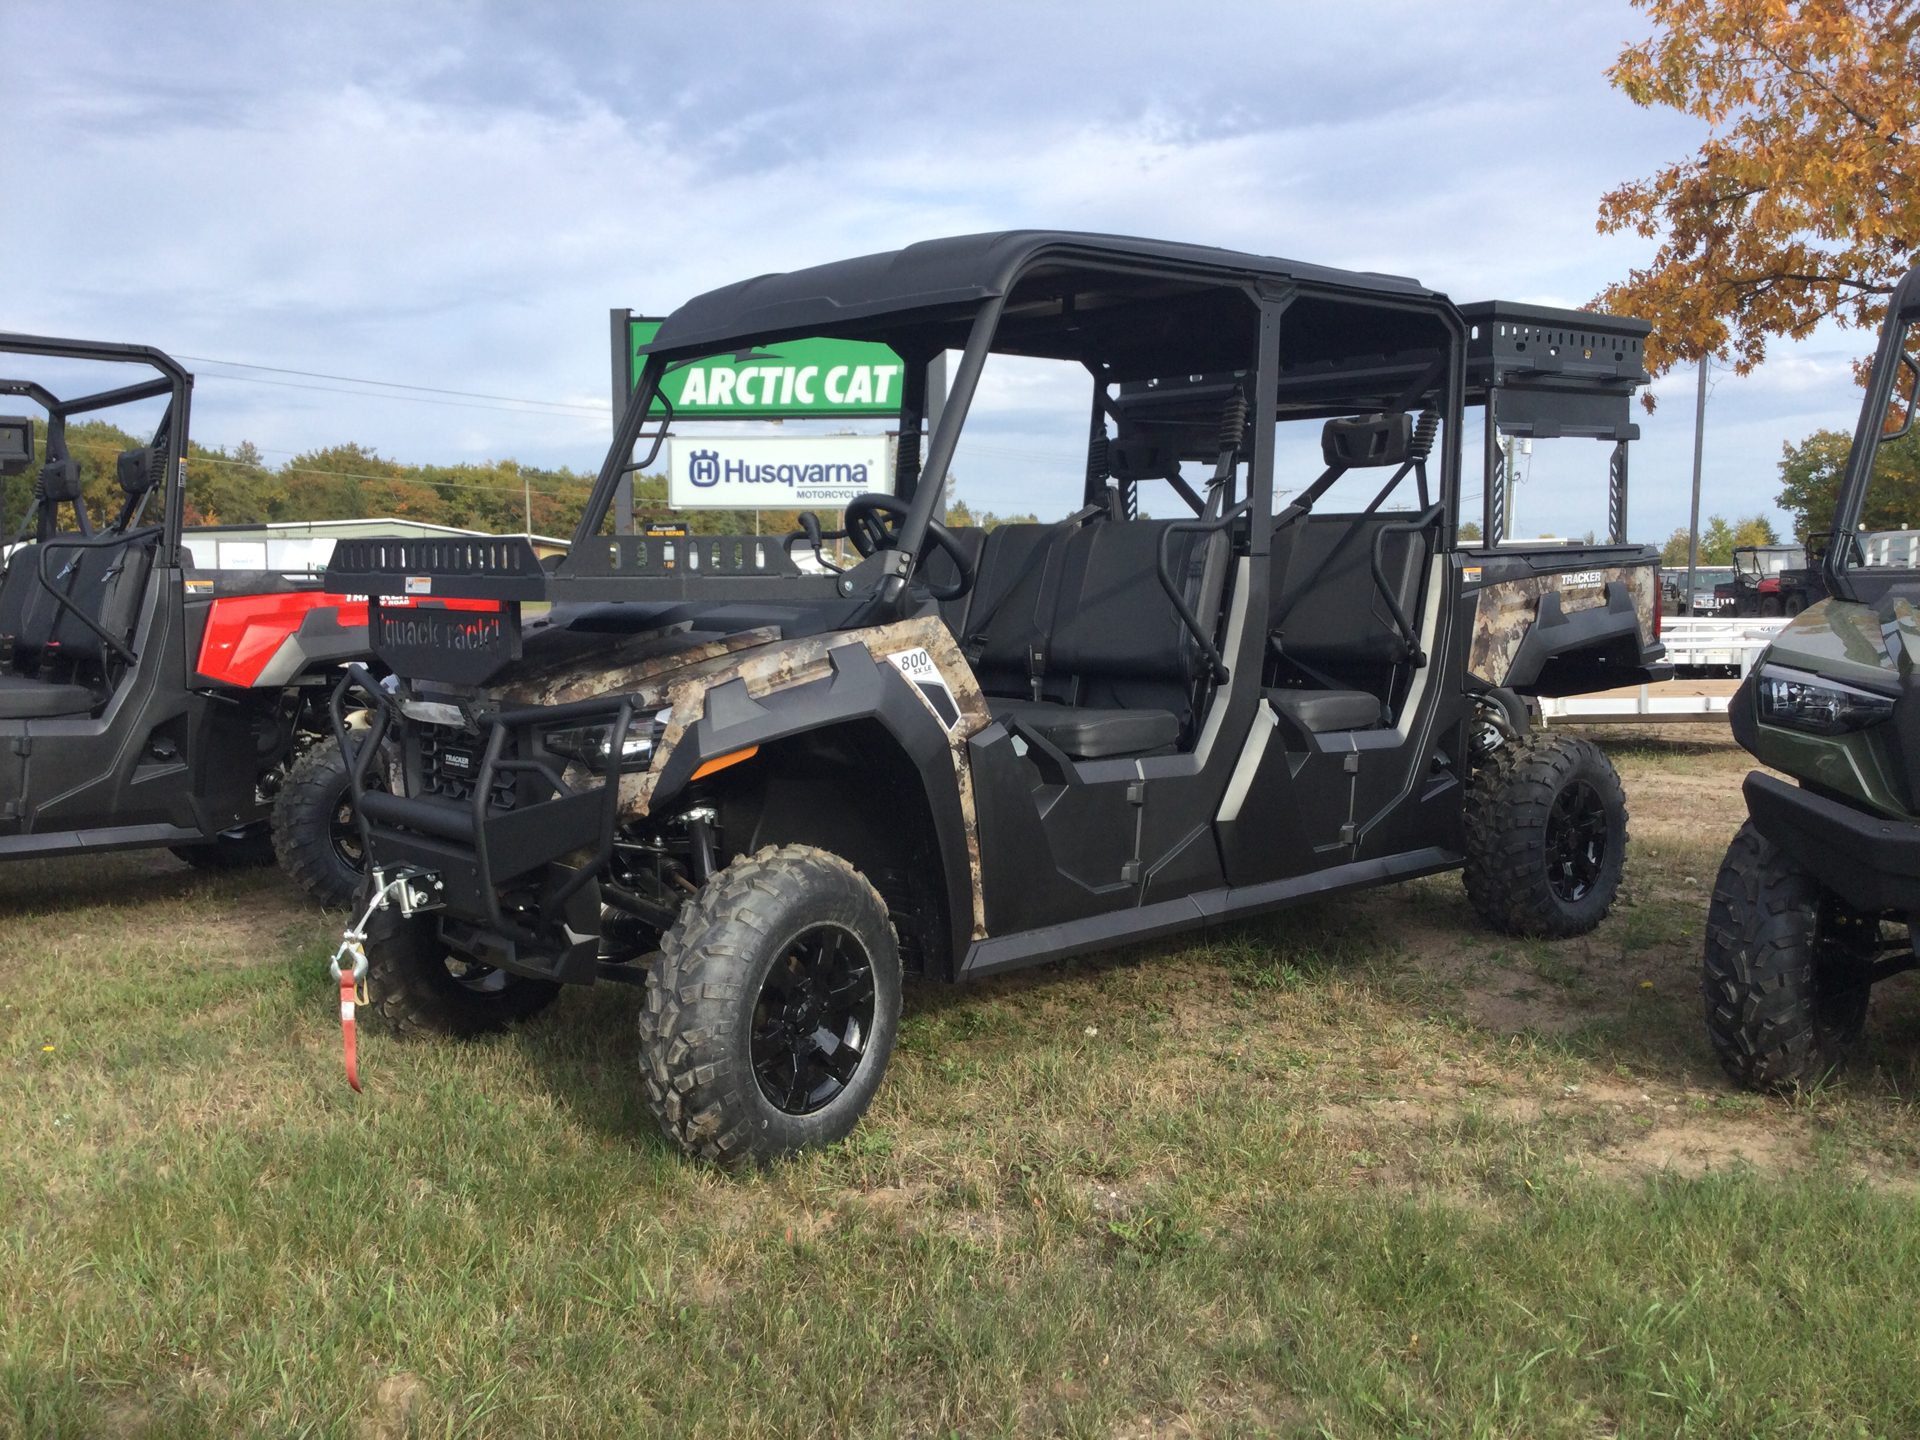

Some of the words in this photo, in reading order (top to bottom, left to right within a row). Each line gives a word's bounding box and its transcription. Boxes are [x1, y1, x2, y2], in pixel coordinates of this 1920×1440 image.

[679, 366, 818, 405] ARCTIC
[824, 365, 898, 403] CAT
[725, 459, 867, 487] Husqvarna
[1561, 571, 1601, 585] TRACKER
[901, 651, 927, 671] 800
[913, 667, 922, 675] SX
[445, 754, 469, 765] TRACKER
